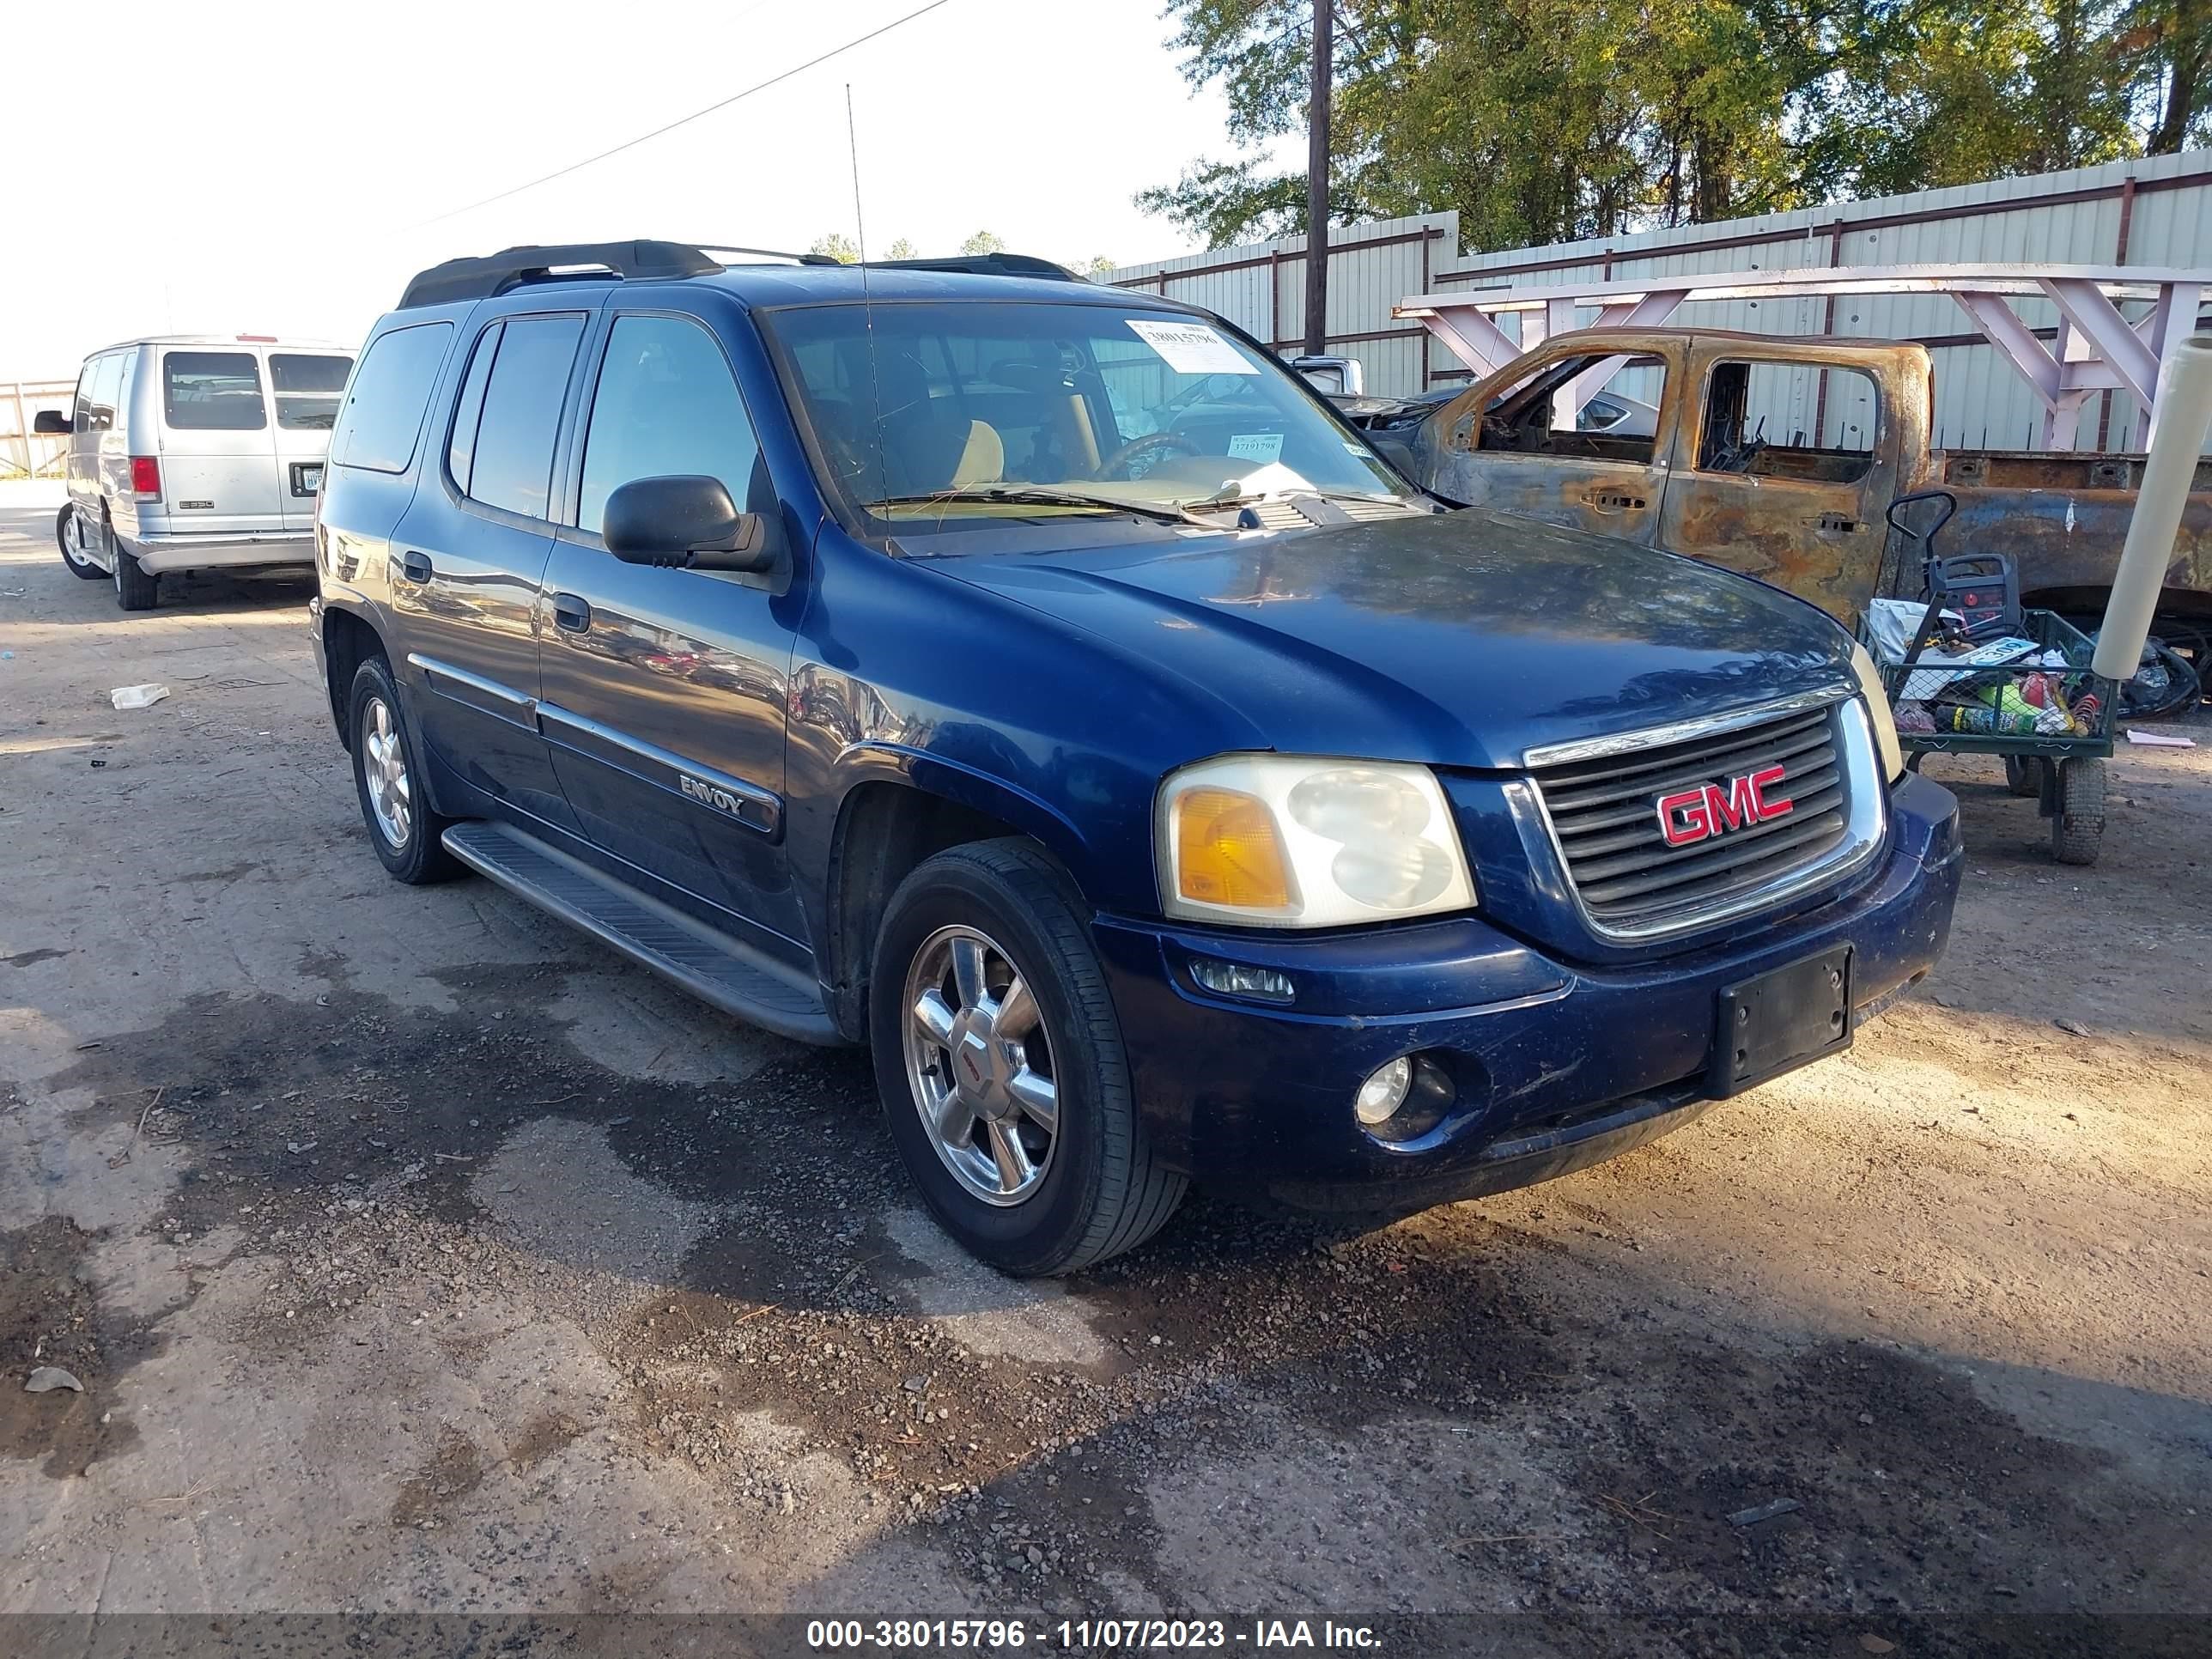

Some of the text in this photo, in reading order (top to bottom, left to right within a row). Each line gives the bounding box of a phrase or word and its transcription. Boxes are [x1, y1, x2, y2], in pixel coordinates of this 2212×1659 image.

[1147, 331, 1218, 344] 38015796
[679, 775, 744, 816] ENVOY
[1656, 764, 1794, 848] GMC
